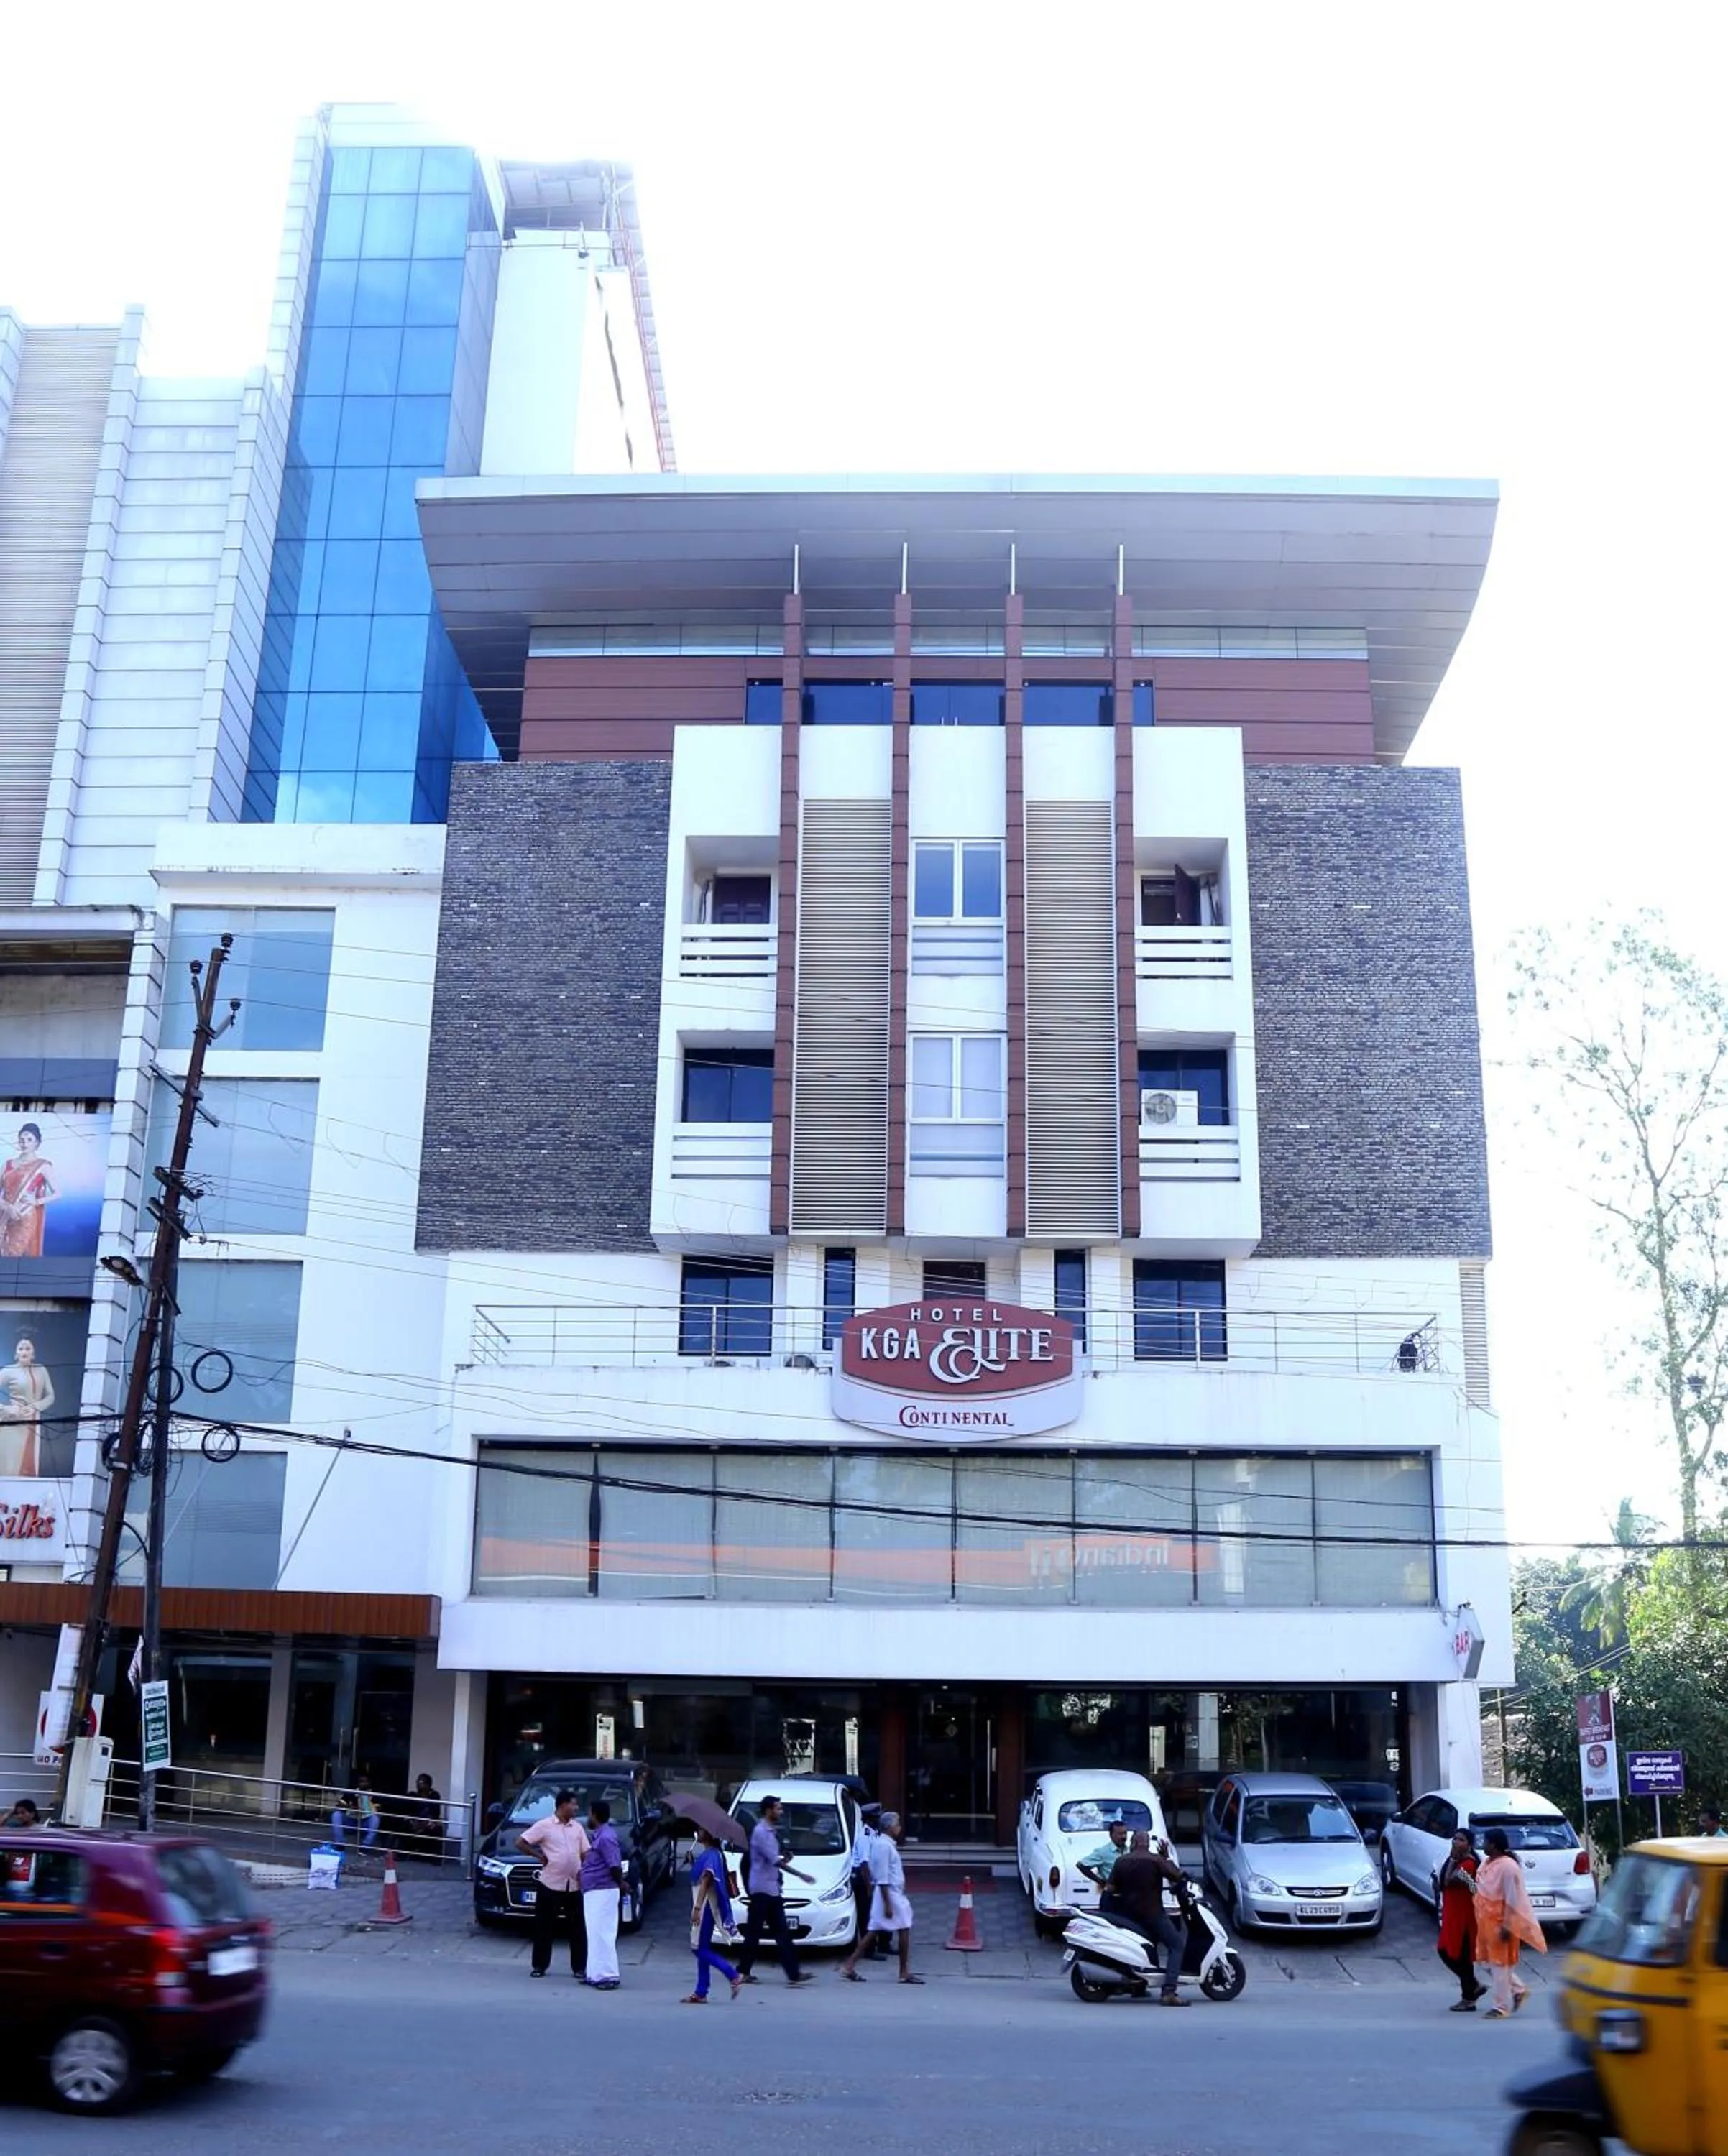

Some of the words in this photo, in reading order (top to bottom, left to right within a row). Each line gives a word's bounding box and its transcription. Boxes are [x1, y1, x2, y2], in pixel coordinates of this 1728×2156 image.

[910, 1307, 1003, 1322] HOTEL
[861, 1327, 922, 1360] KGA
[1455, 1631, 1471, 1655] BAR
